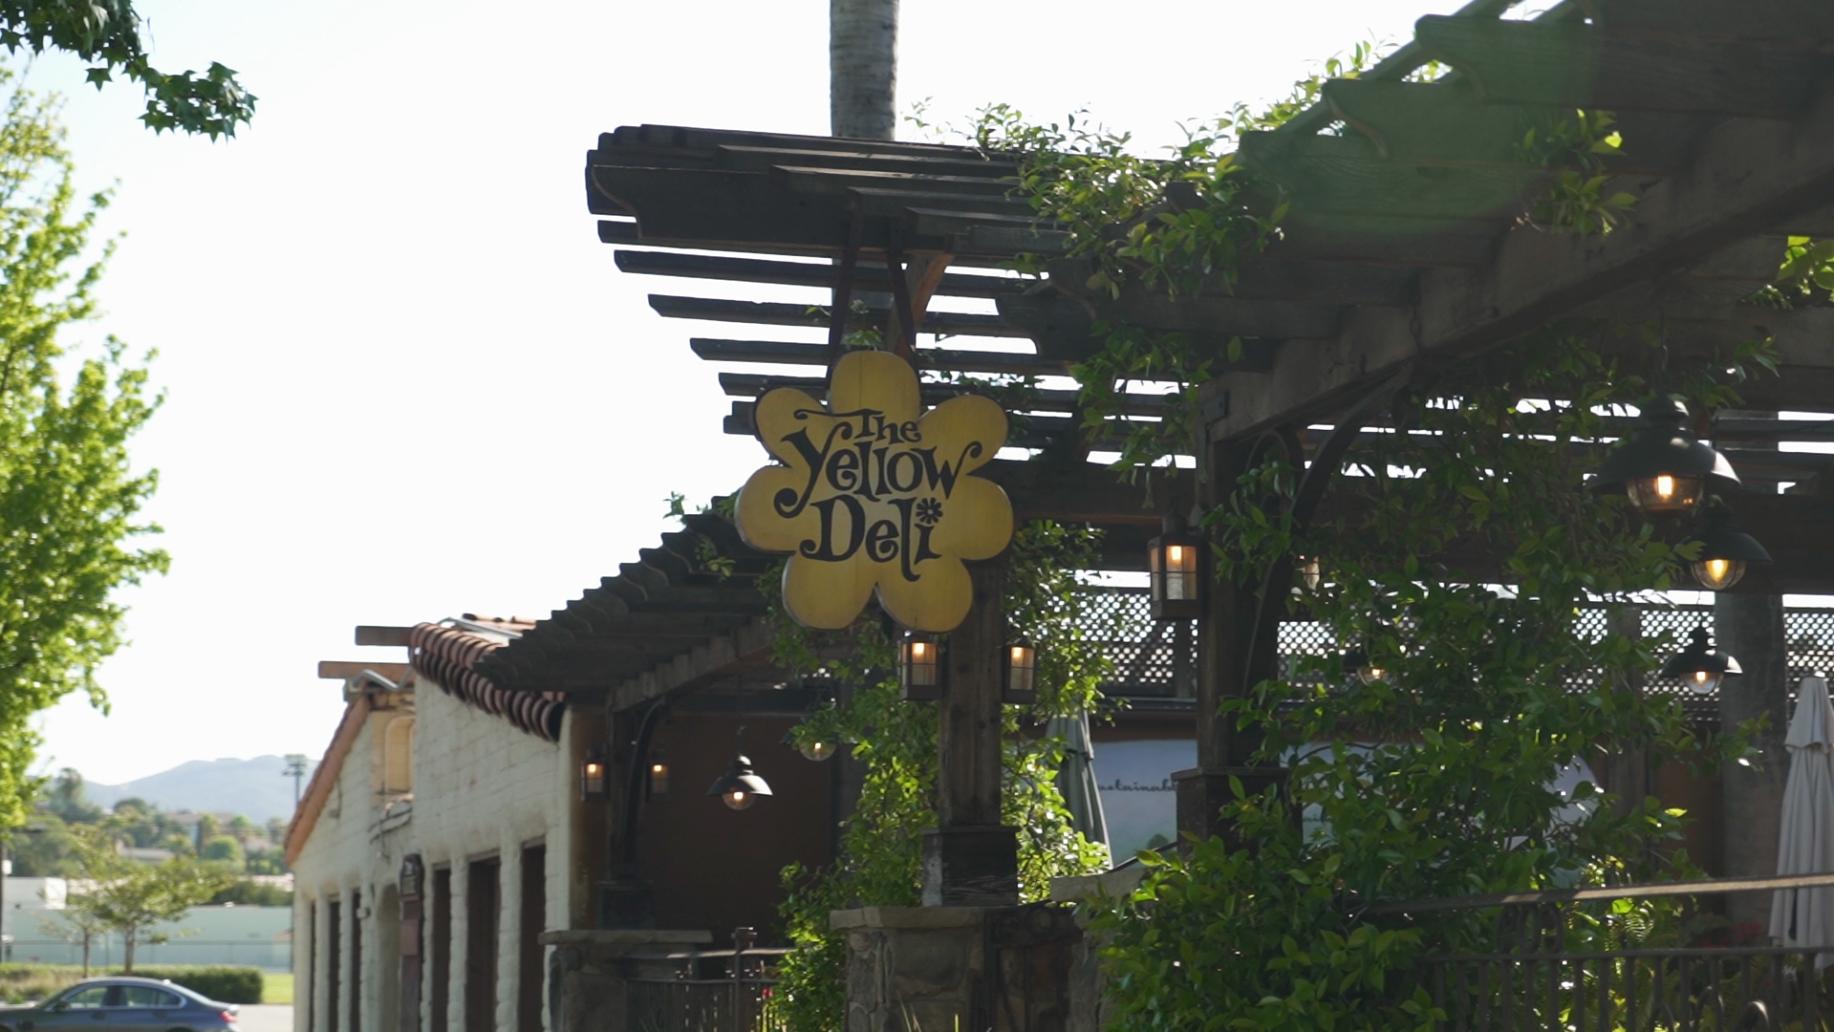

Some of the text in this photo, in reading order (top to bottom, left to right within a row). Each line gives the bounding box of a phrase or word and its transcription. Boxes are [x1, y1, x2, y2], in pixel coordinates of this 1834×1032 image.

[793, 408, 922, 443] The
[773, 421, 983, 519] Yellow
[799, 494, 943, 582] Deli
